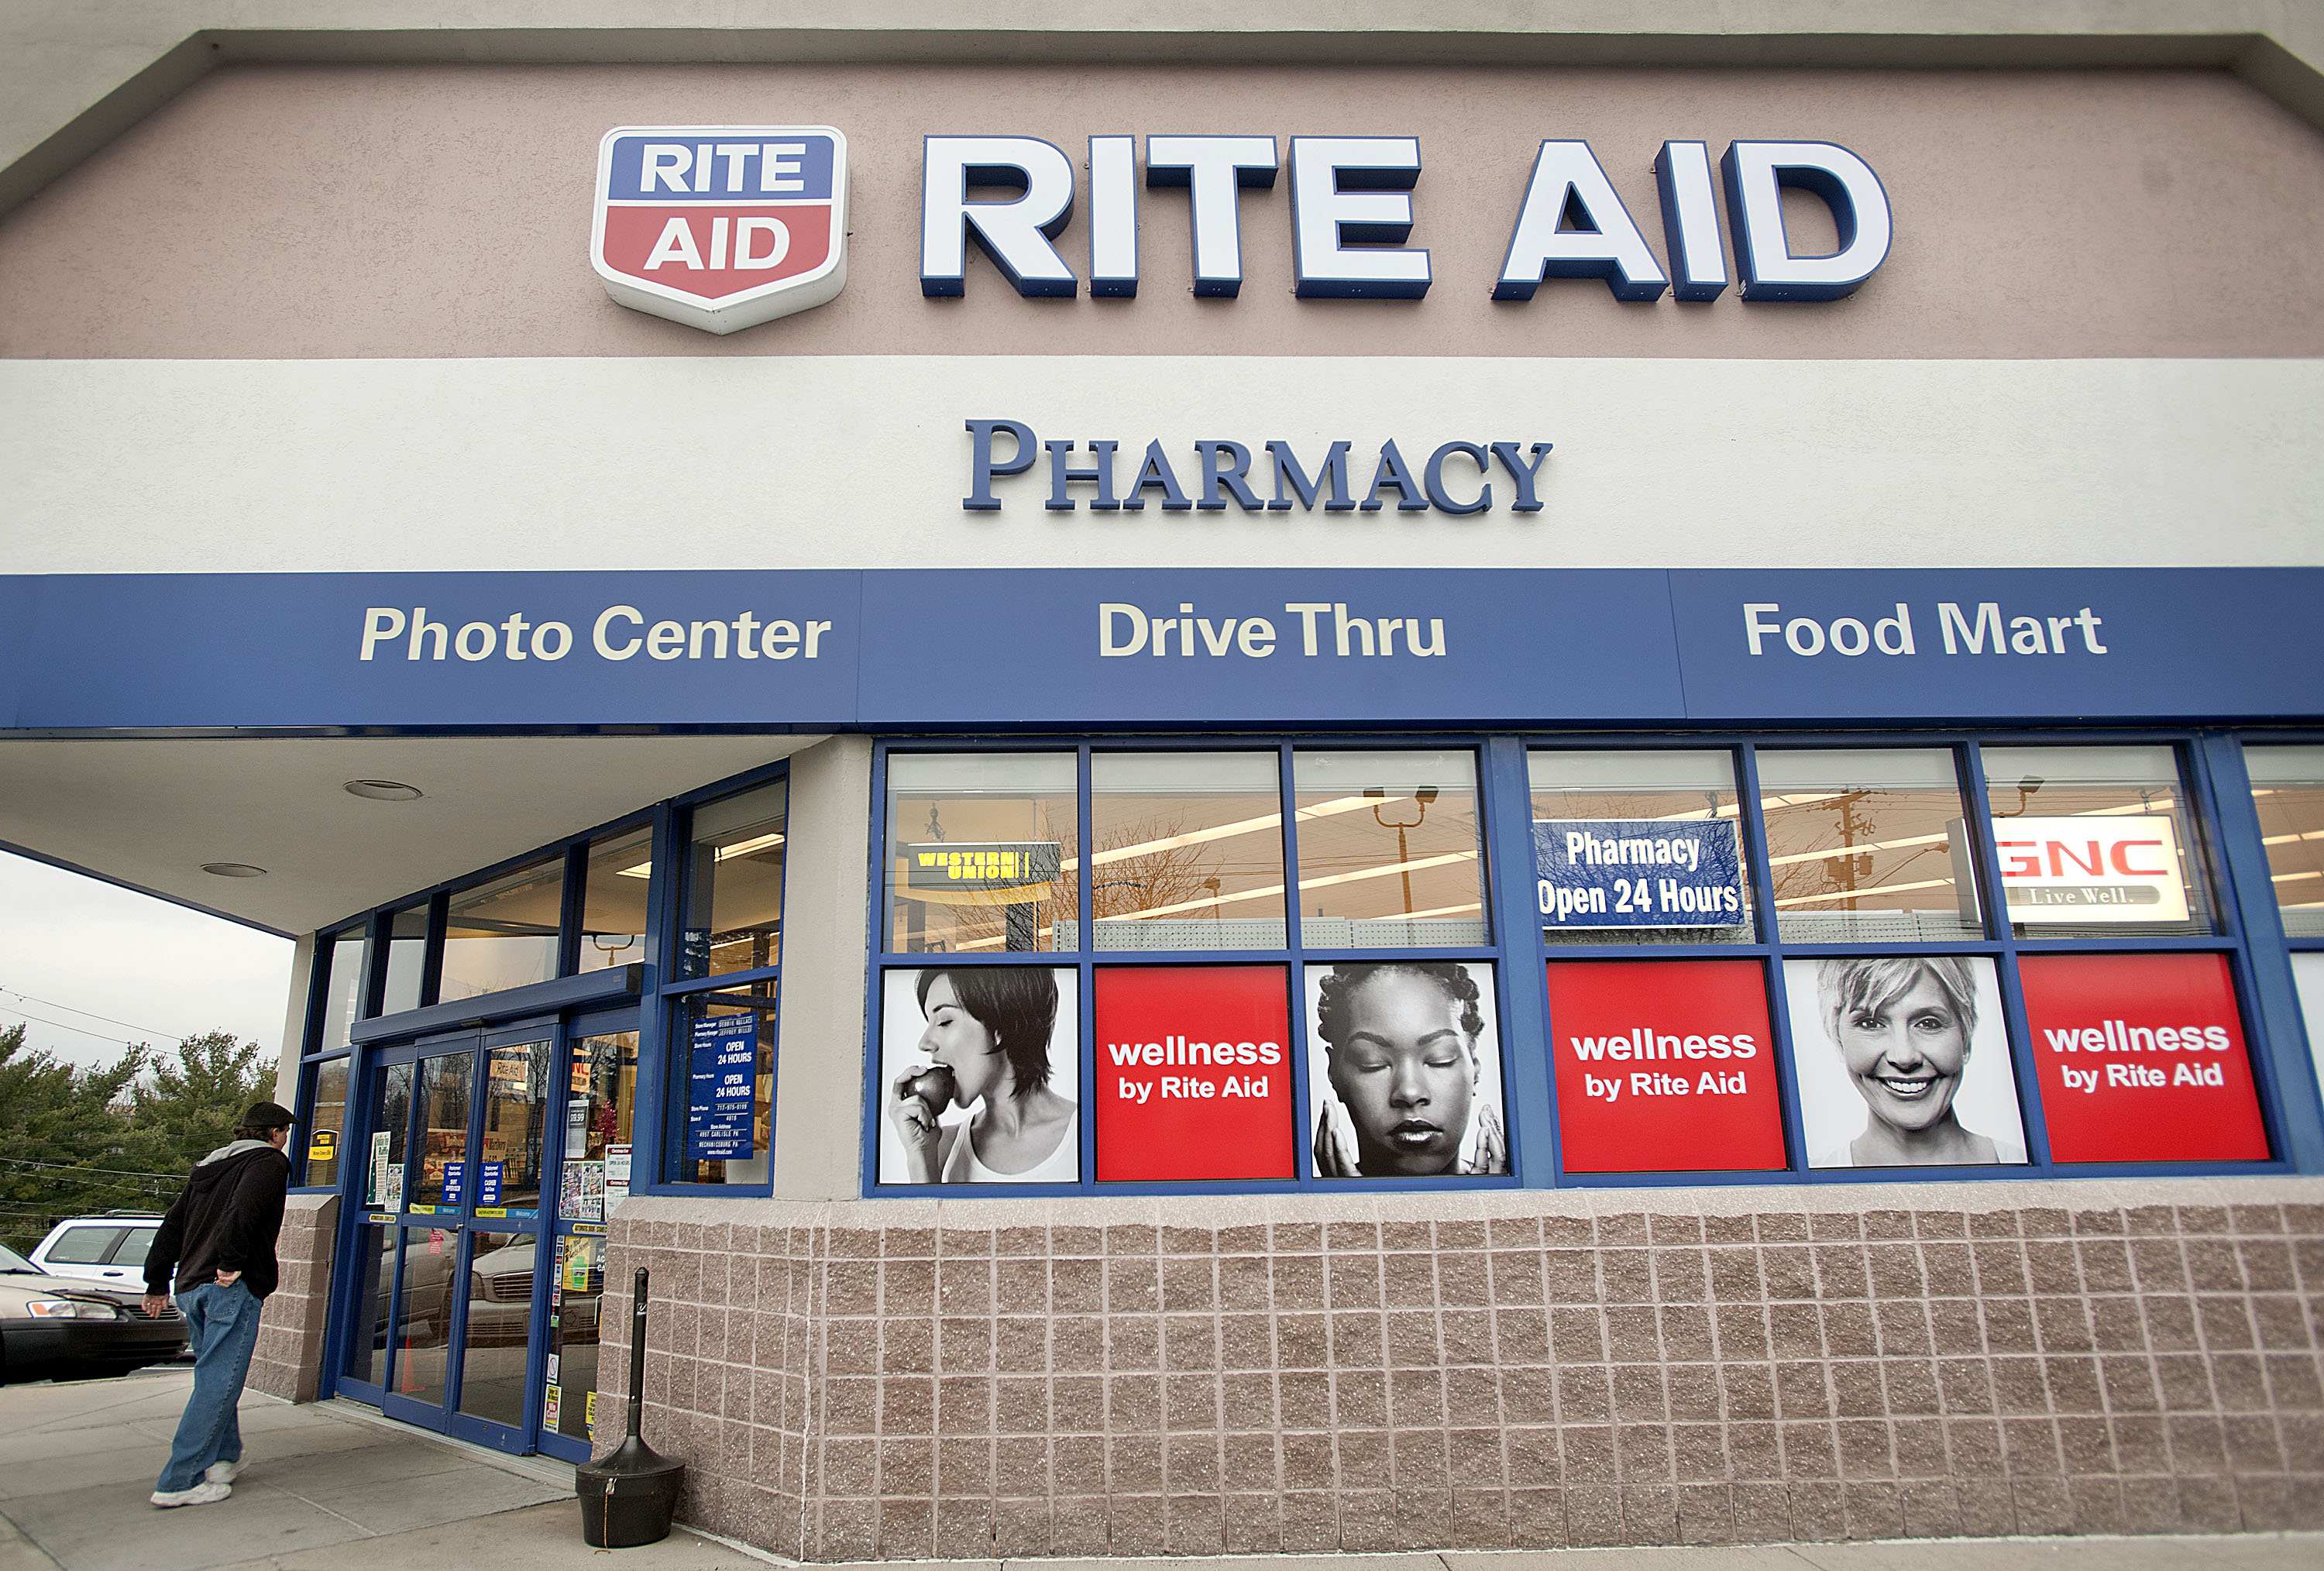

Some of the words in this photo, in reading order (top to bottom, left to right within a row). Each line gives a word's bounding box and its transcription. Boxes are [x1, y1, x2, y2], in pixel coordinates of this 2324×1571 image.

[640, 143, 805, 193] RITE
[920, 135, 1433, 300] RITE
[1490, 139, 1893, 301] AID
[643, 217, 790, 270] AID
[961, 418, 1553, 515] PHARMACY
[359, 605, 573, 662] Photo
[592, 603, 831, 662] Center
[1098, 602, 1277, 658] Drive
[1285, 602, 1447, 658] Thru
[1742, 602, 1917, 656] Food
[1937, 601, 2109, 655] Mart
[917, 851, 1016, 867] WESTERN
[1566, 831, 1700, 872] Pharmacy
[1996, 840, 2169, 877] GNC
[947, 865, 1016, 880] UNION
[1537, 879, 1607, 922] Open
[1614, 878, 1652, 913] 24
[1659, 878, 1739, 913] Hours
[2028, 888, 2076, 905] Live
[2080, 887, 2134, 905] Well.
[726, 1040, 744, 1053] OPEN
[1108, 1035, 1281, 1066] wellness
[1570, 1028, 1757, 1061] wellness
[2043, 1019, 2230, 1053] wellness
[717, 1054, 727, 1065] 24
[727, 1051, 752, 1064] HOURS
[716, 1087, 725, 1098] 24
[726, 1085, 751, 1097] HOURS
[724, 1074, 743, 1085] OPEN
[1119, 1076, 1153, 1105] by
[1161, 1076, 1215, 1098] Rite
[1221, 1075, 1269, 1098] Aid
[1584, 1073, 1622, 1102] by
[1630, 1072, 1690, 1095] Rite
[1697, 1071, 1747, 1095] Aid
[2061, 1064, 2099, 1094] by
[2106, 1064, 2167, 1087] Rite
[2173, 1062, 2224, 1087] Aid
